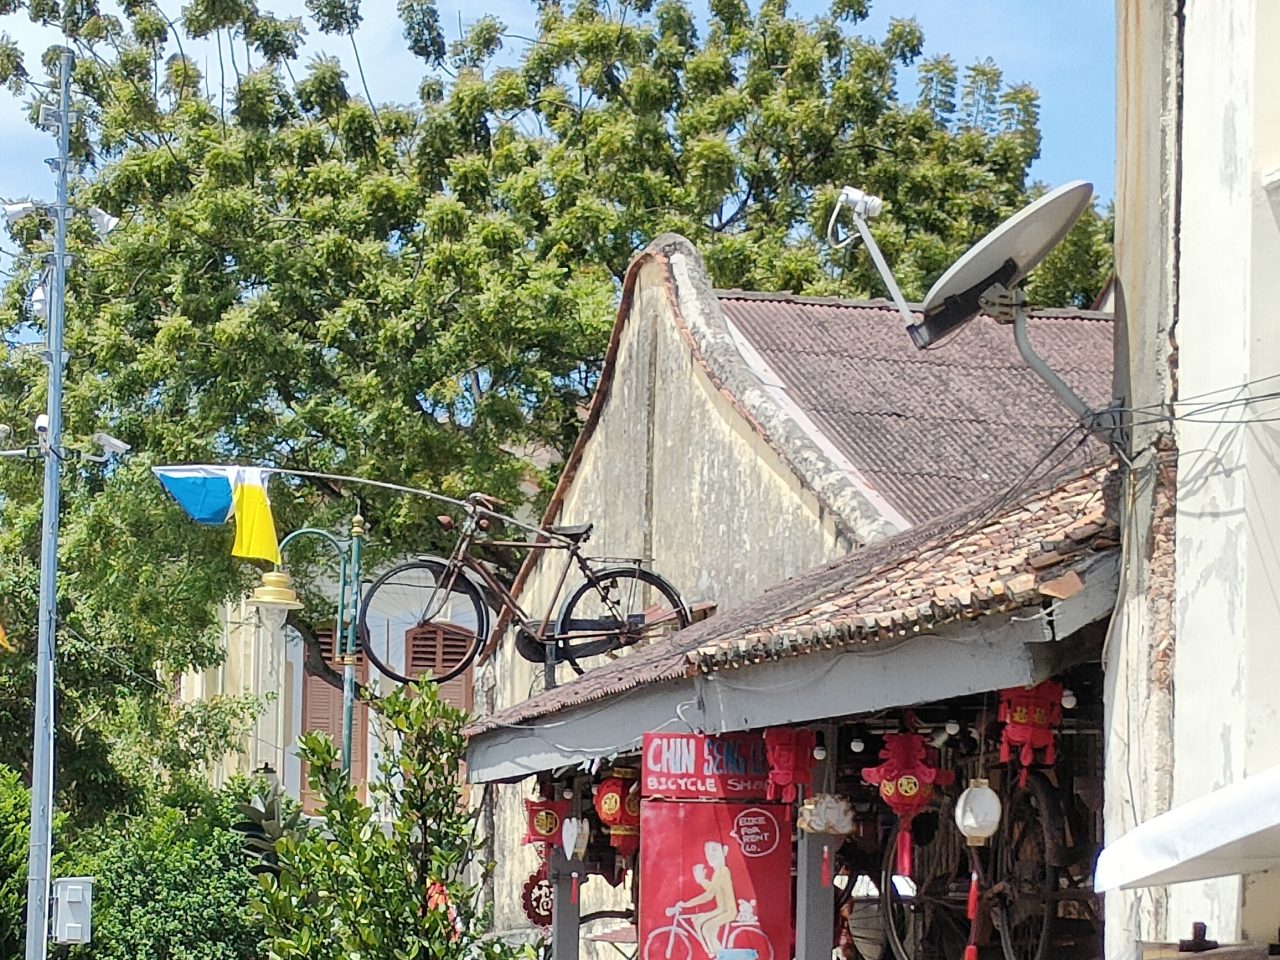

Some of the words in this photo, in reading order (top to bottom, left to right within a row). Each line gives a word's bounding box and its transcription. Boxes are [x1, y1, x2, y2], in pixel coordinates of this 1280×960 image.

[646, 737, 696, 775] CHIN
[646, 776, 718, 793] BICYCLE
[742, 832, 769, 843] RENT
